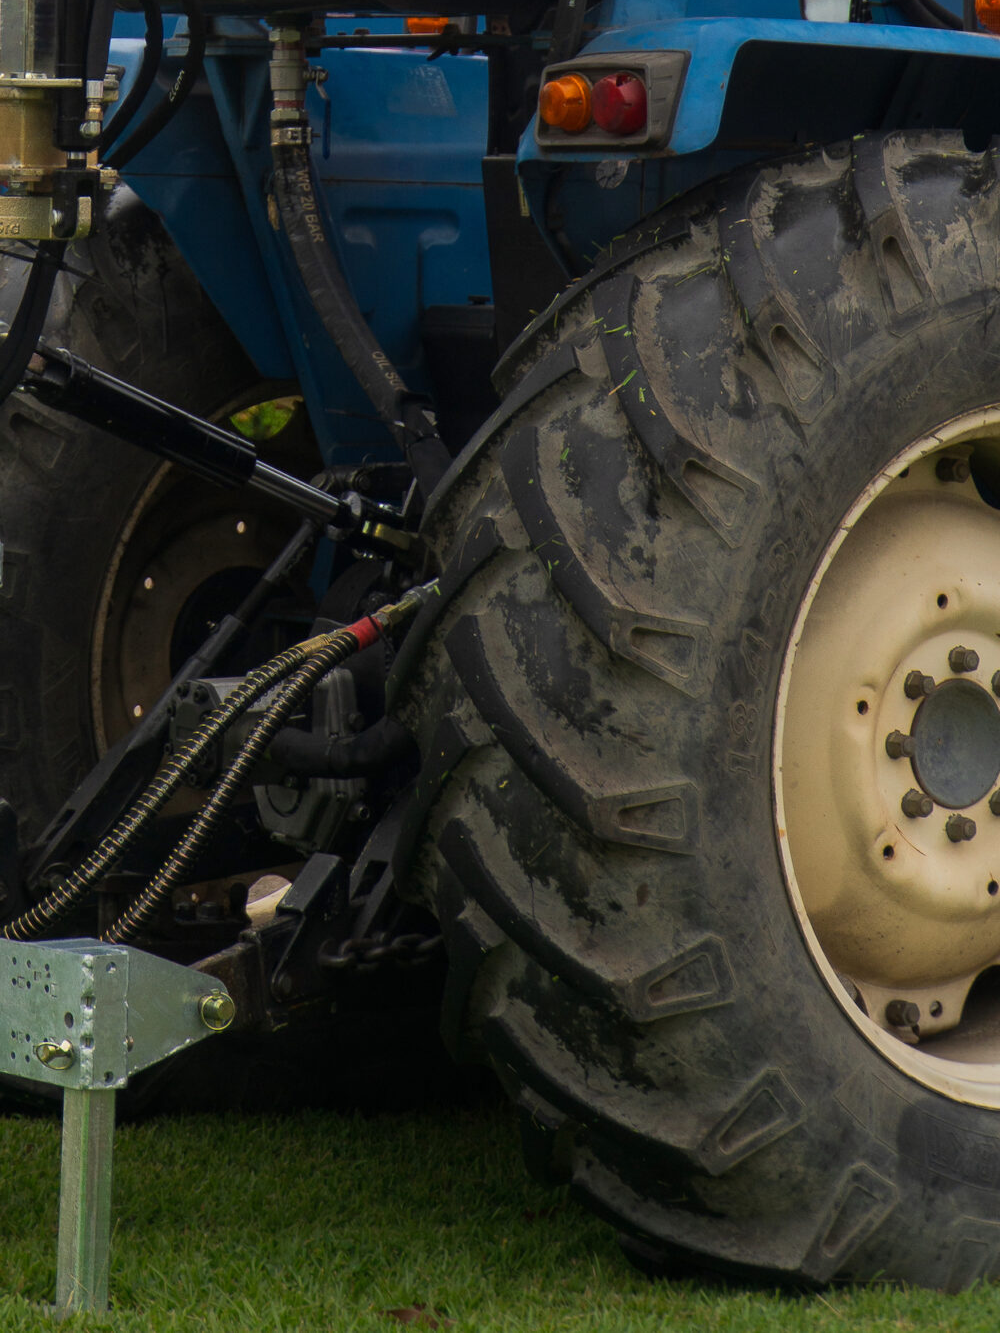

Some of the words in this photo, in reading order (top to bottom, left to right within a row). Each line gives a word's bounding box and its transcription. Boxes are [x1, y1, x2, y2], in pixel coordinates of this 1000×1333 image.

[296, 168, 311, 192] WP
[301, 195, 315, 211] 20
[305, 213, 325, 243] BAR
[372, 351, 390, 370] OIL
